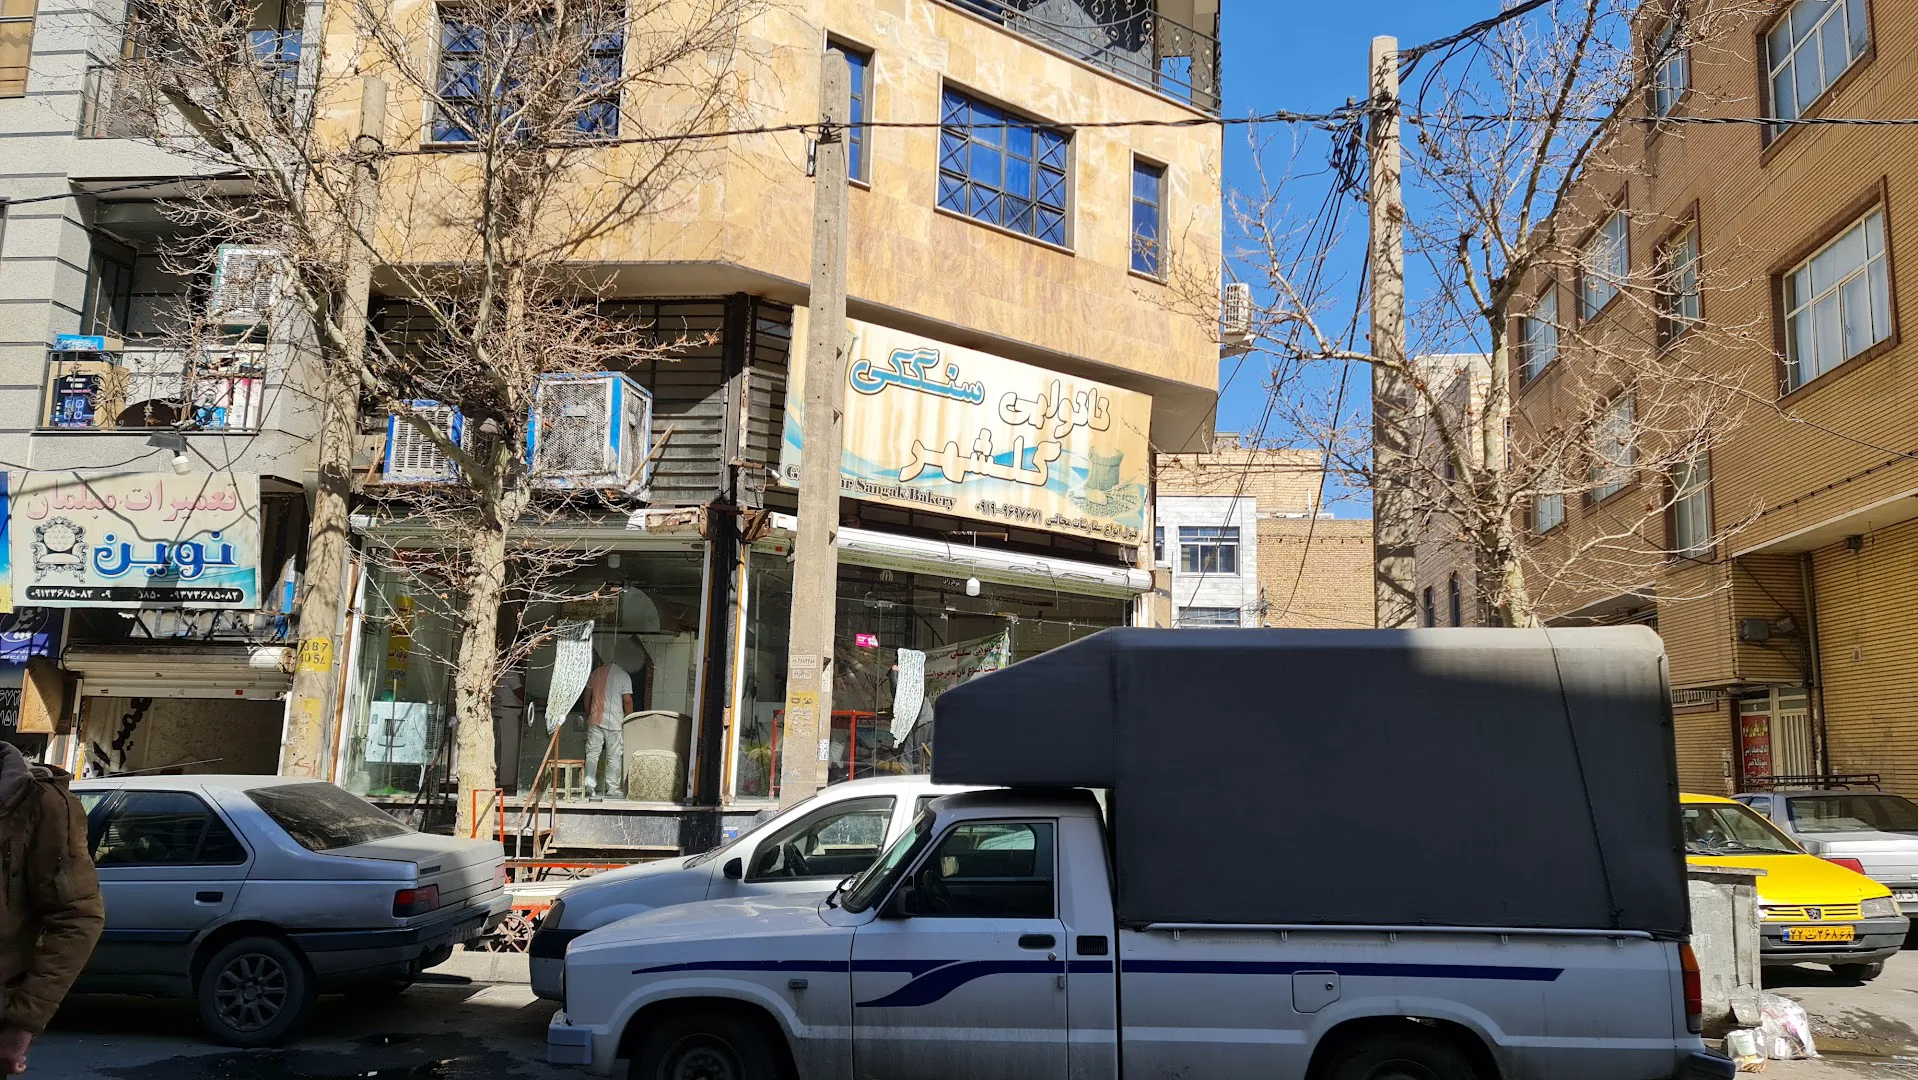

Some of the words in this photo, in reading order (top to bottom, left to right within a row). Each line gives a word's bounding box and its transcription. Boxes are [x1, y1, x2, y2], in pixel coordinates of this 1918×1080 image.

[849, 348, 985, 405] سنگکی
[898, 428, 1062, 486] گلشهر
[26, 479, 117, 520] مبلمان
[125, 480, 238, 521] تعمیرات
[856, 477, 908, 500] Sangak
[909, 487, 957, 511] Bakery
[1103, 523, 1122, 538] انواع
[93, 530, 239, 579] نوین
